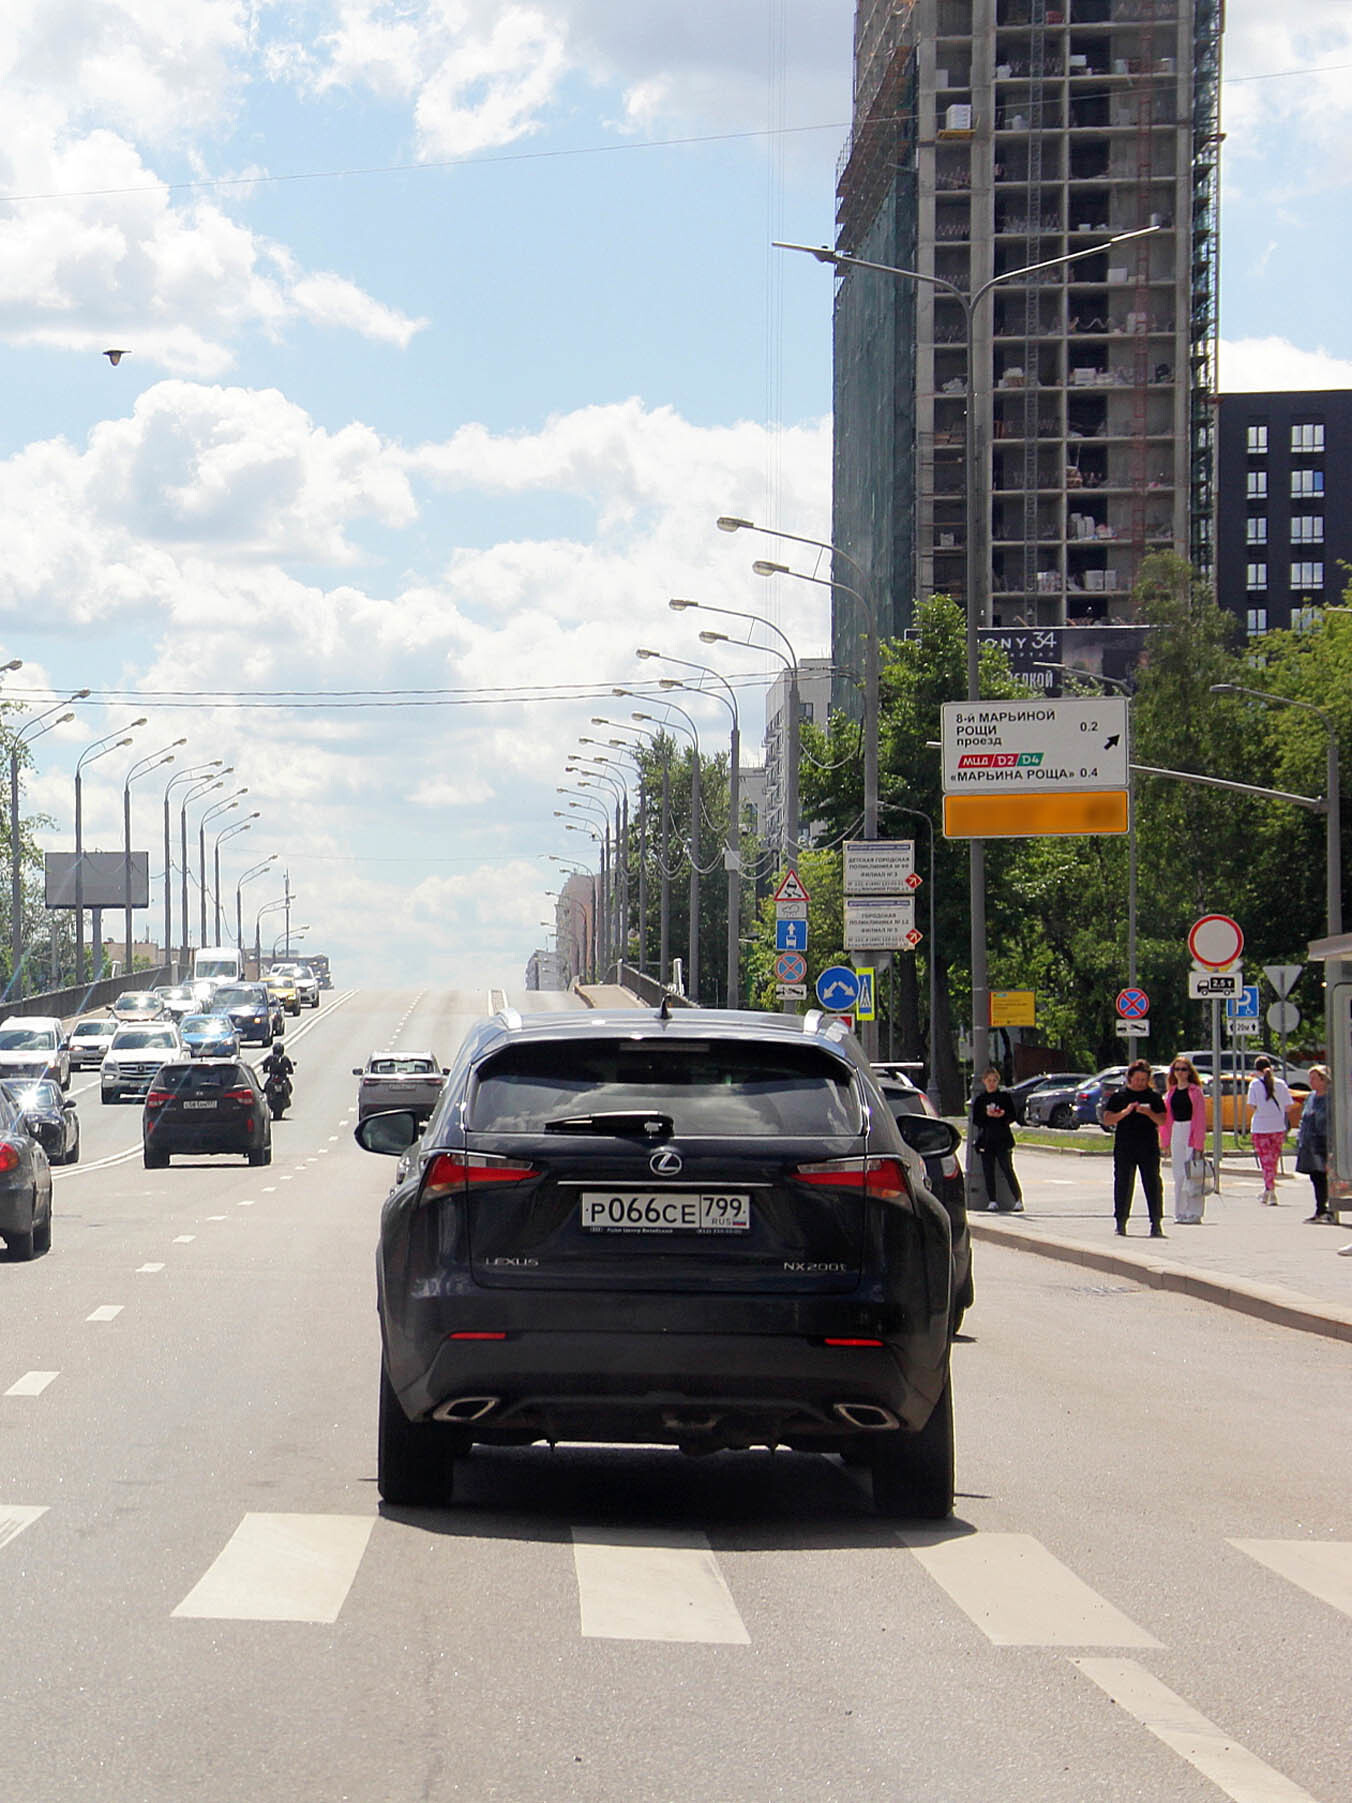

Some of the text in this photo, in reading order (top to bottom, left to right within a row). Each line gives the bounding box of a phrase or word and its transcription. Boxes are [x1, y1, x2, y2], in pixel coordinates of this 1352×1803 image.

[1031, 632, 1056, 649] 34
[956, 710, 1055, 723] 8-й МАРЬИНОЙ
[956, 725, 997, 736] РОЩИ
[1080, 721, 1098, 732] 0.2
[957, 737, 1002, 748] проезд
[962, 757, 989, 766] МЦД
[997, 755, 1040, 765] D2 D4
[951, 767, 1098, 781] «МАРЬИНА РОЩА» 0.4
[591, 1197, 742, 1224] Р066СЕ 799
[712, 1218, 732, 1226] RUS
[485, 1257, 539, 1266] LEXUS
